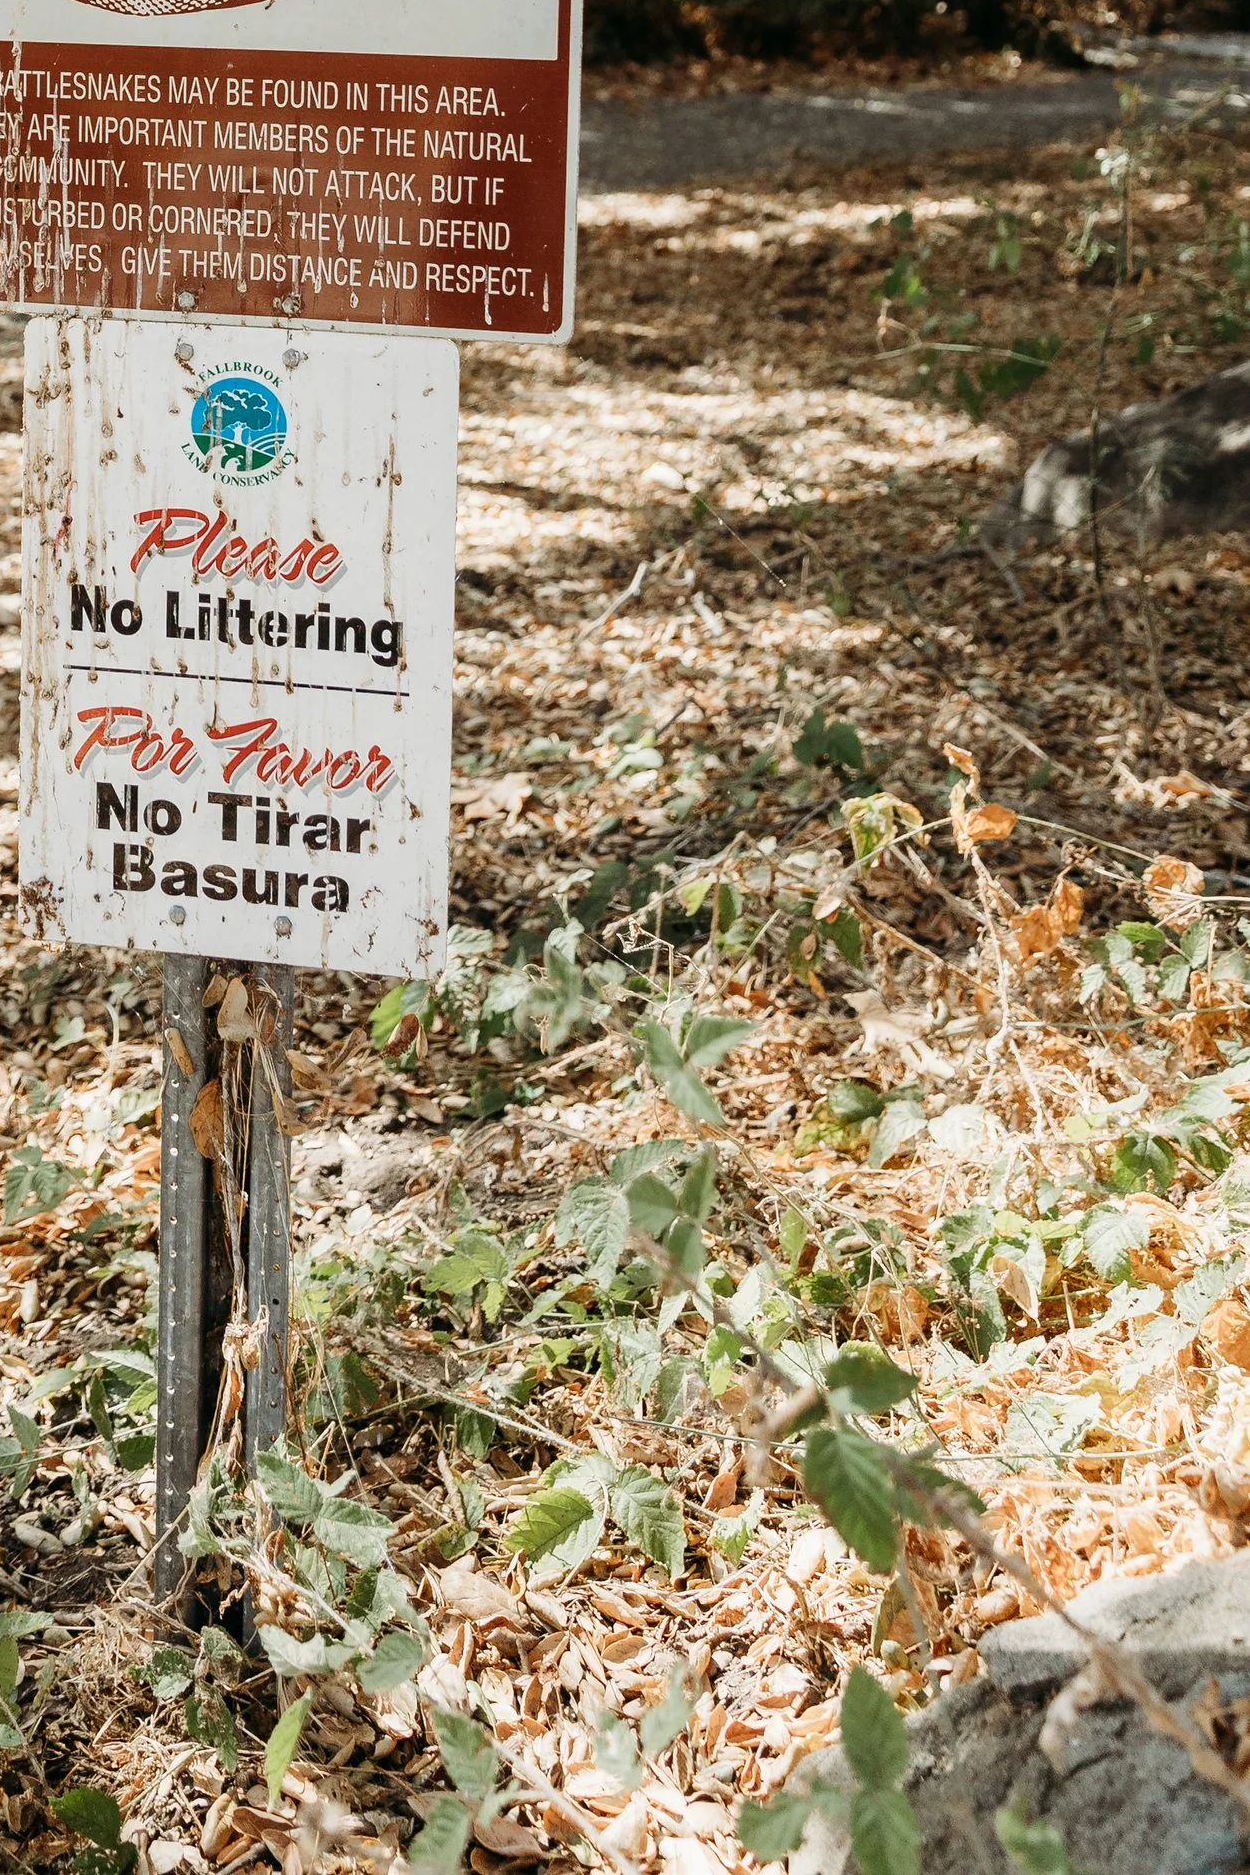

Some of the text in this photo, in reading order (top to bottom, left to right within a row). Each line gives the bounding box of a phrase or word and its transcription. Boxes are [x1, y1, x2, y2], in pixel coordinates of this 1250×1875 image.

[168, 75, 219, 105] MAY
[226, 77, 254, 107] BE
[261, 79, 339, 109] FOUND
[346, 82, 368, 111] IN
[376, 83, 429, 114] THIS
[435, 85, 505, 117] AREA.
[27, 113, 71, 142] ARE
[78, 115, 207, 148] IMPORTANT
[214, 121, 329, 154] MEMBERS
[336, 125, 365, 155] OF
[371, 127, 416, 157] THE
[423, 129, 532, 163] NATURAL
[143, 161, 202, 191] THEY
[208, 164, 265, 194] WILL
[272, 167, 319, 196] NOT
[325, 169, 423, 206] ATTACK,
[431, 174, 478, 205] BUT
[485, 177, 505, 206] IF
[112, 202, 143, 232] OR
[287, 210, 347, 241] THEY
[354, 214, 412, 246] WILL
[419, 218, 510, 251] DEFEND
[121, 246, 171, 276] GIVE
[178, 249, 241, 280] THEM
[250, 253, 362, 286] DISTANCE
[368, 258, 418, 290] AND
[425, 262, 535, 297] RESPECT.
[198, 361, 283, 388] FALLBROOK
[181, 443, 295, 487] LAND CONSERVANCY
[130, 507, 344, 585] Please
[70, 584, 404, 667] No Littering
[74, 706, 396, 793] Por Favor
[96, 781, 370, 854] No Tirar
[112, 842, 350, 914] Basura
